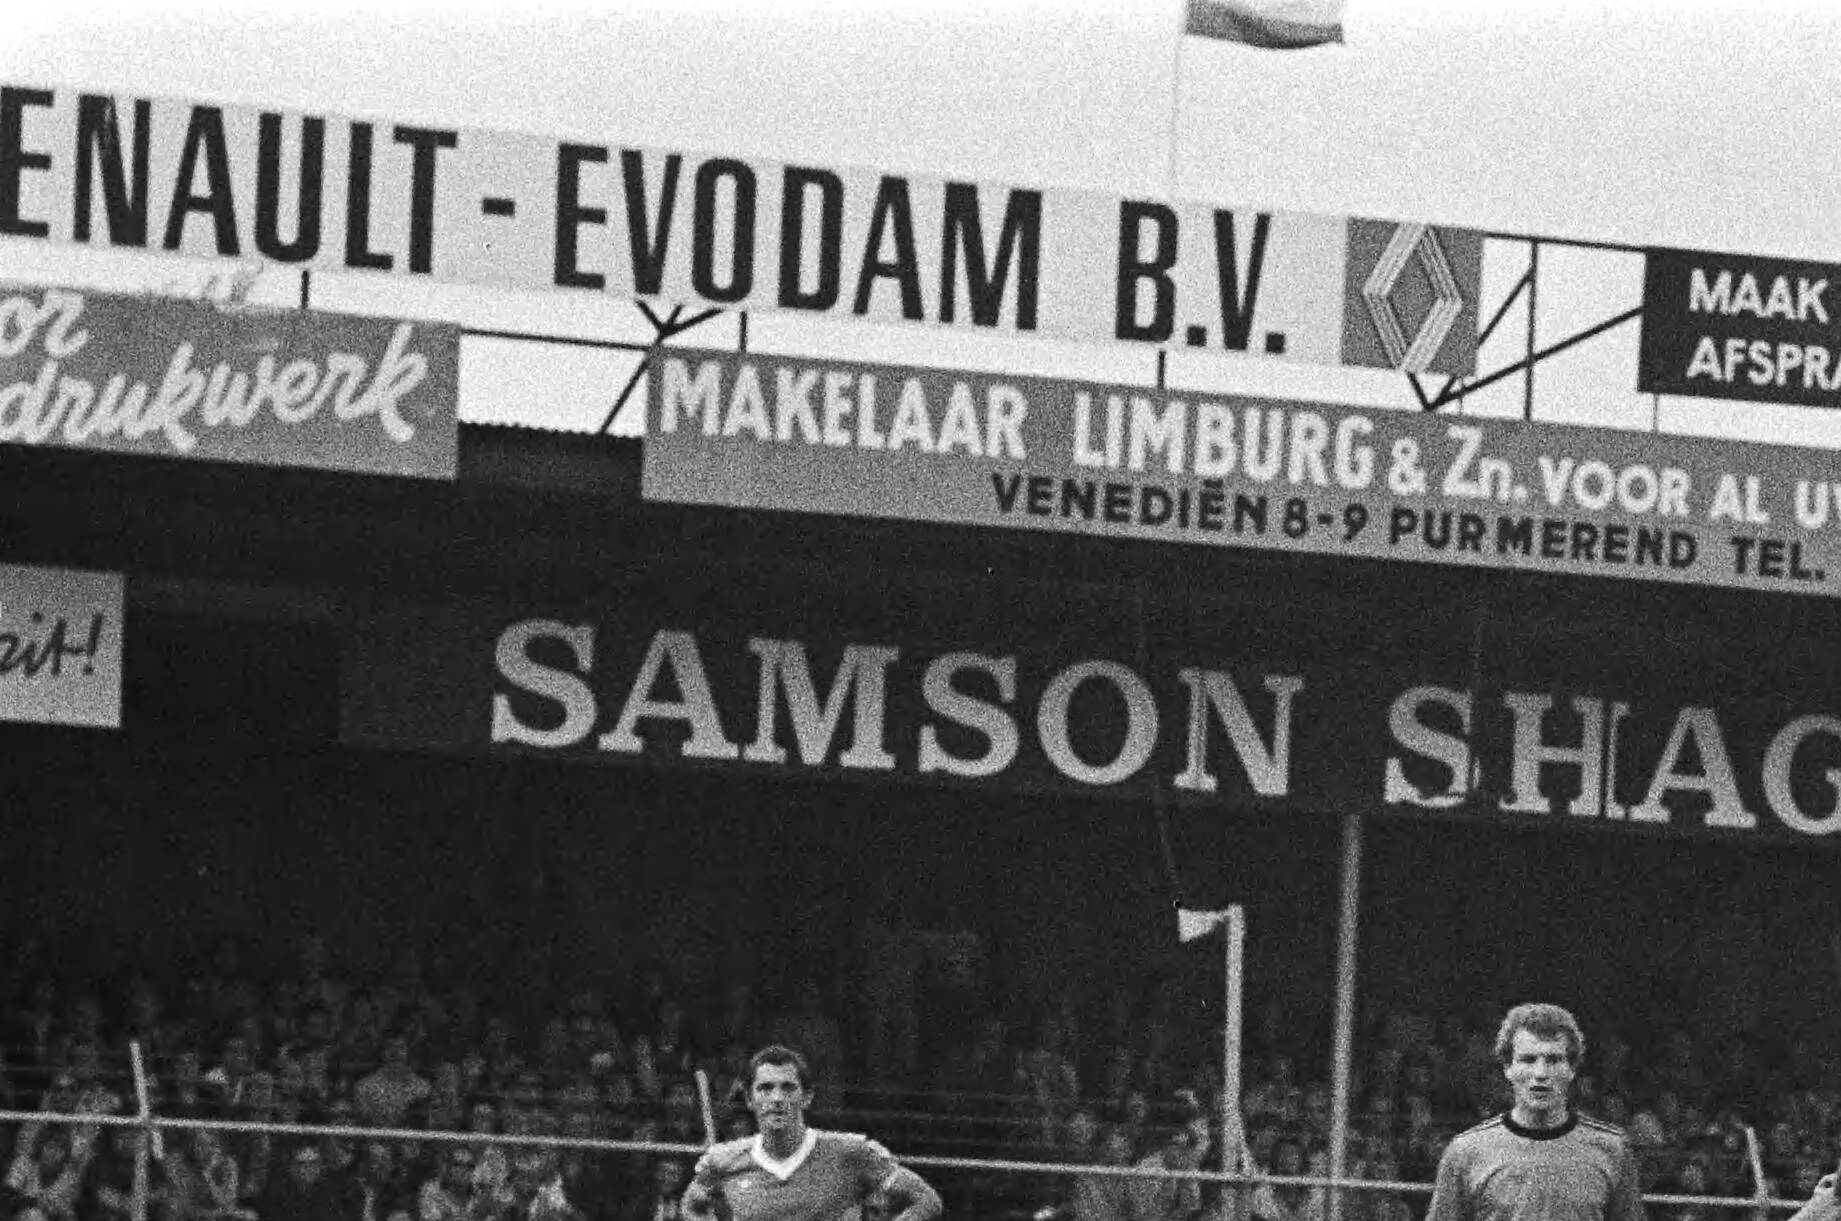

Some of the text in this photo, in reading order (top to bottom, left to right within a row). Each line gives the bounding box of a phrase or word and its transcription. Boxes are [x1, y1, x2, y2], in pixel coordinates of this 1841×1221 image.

[0, 85, 457, 274] ENAULT
[553, 142, 1042, 330] EVODAM
[1115, 199, 1285, 354] B.V.
[1689, 269, 1829, 323] MAAK
[658, 357, 1028, 460] MAKELAAR
[1073, 391, 1375, 490] LIMBURG
[1387, 437, 1427, 496] &
[1442, 425, 1528, 500] Zn.
[1537, 456, 1690, 516] VOOR
[1709, 474, 1769, 525] AL
[992, 473, 1267, 534] VENEDIËN
[1389, 508, 1698, 571] PURMEREND
[1730, 535, 1825, 580] TEL.
[490, 618, 1302, 796] SAMSON
